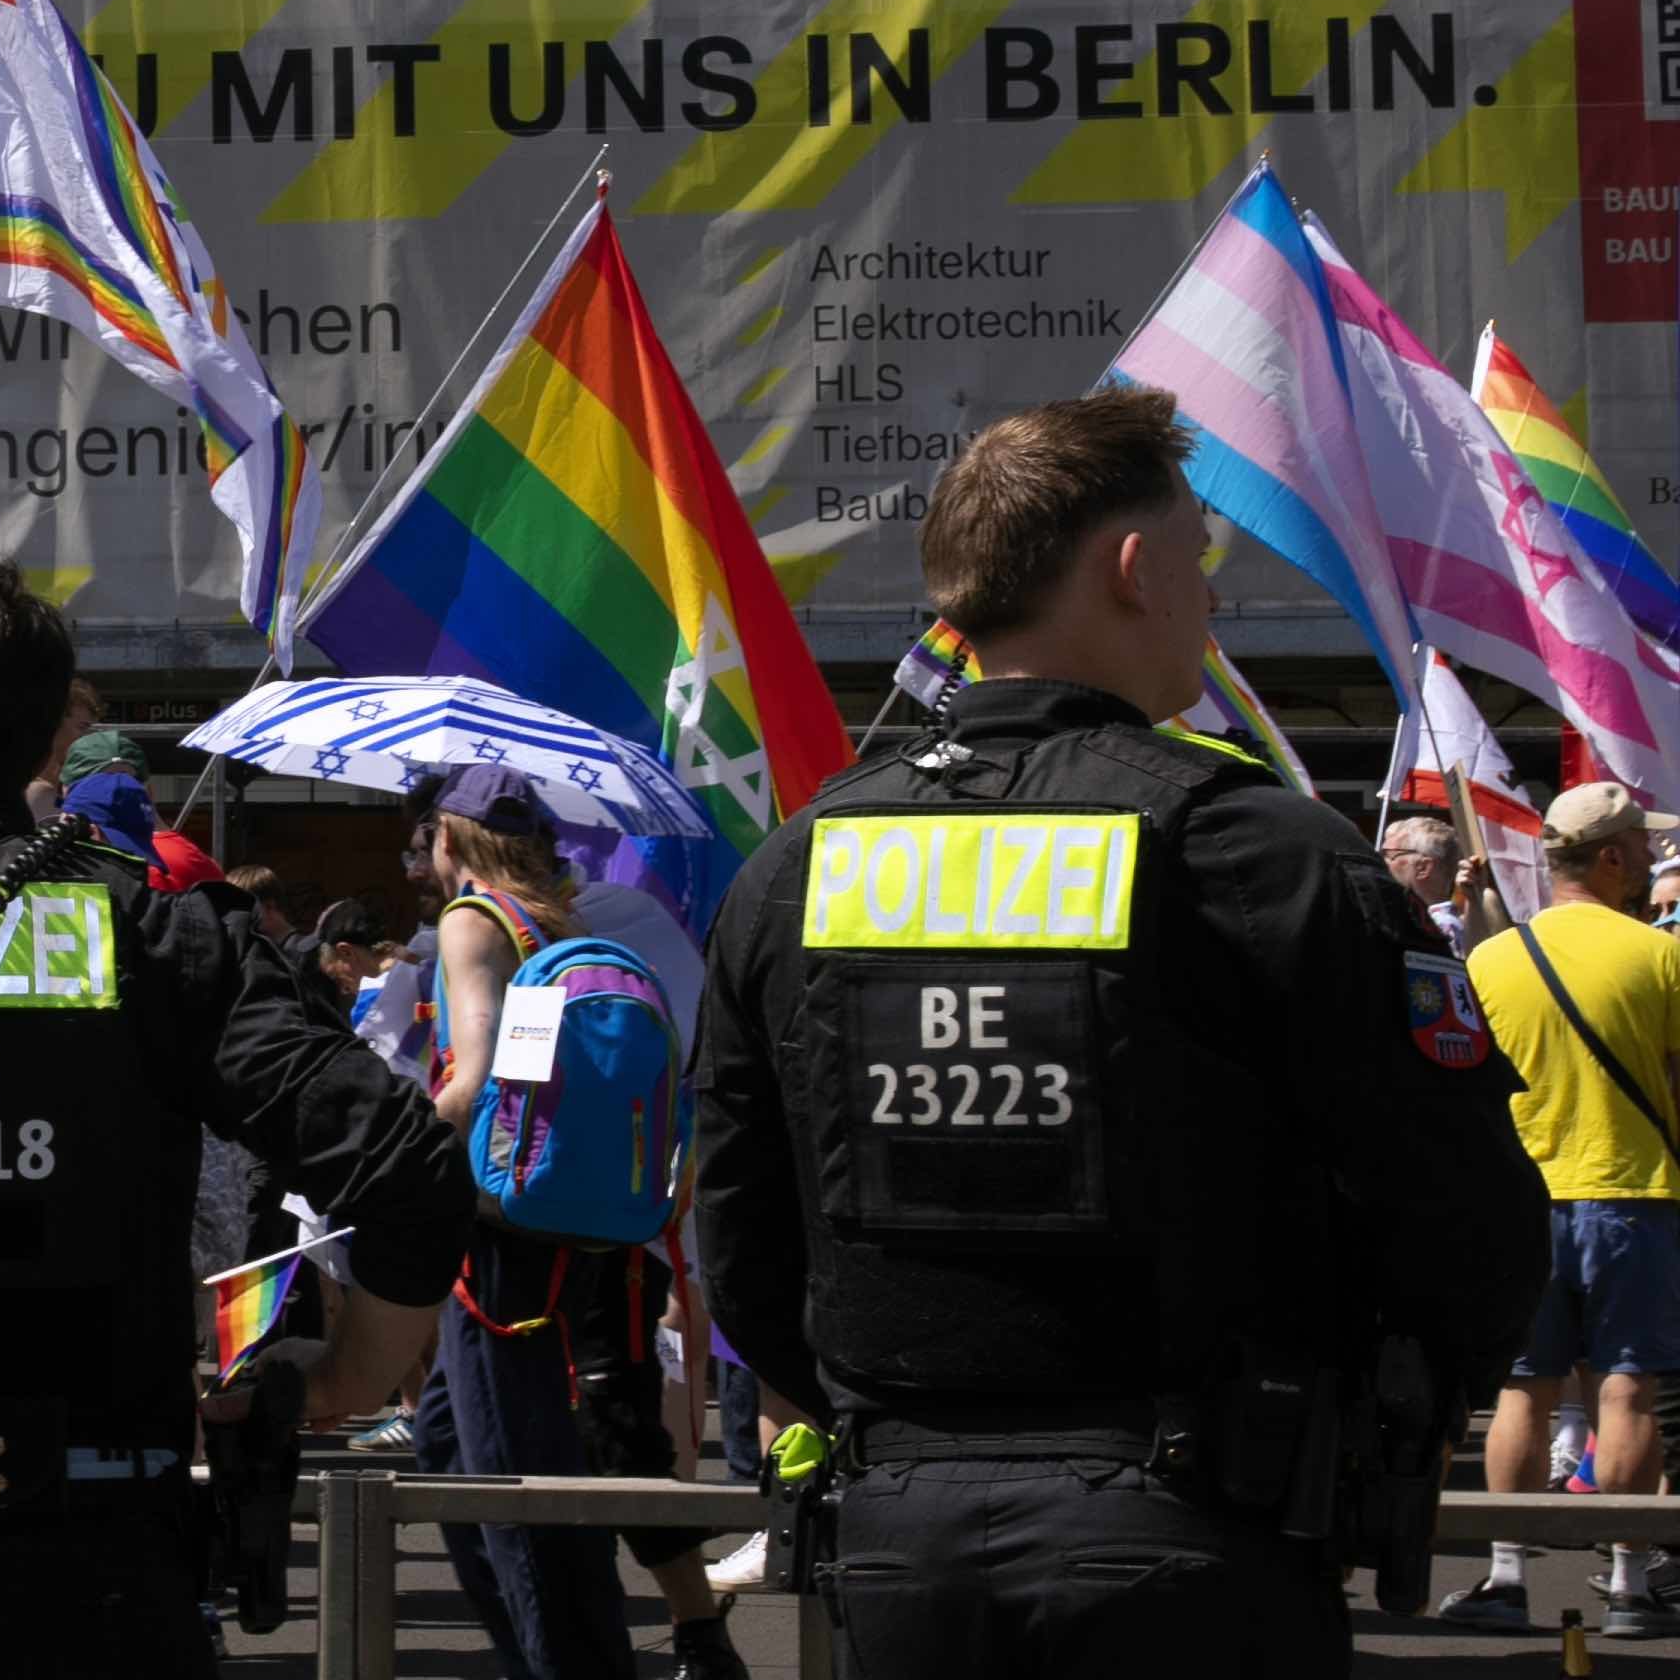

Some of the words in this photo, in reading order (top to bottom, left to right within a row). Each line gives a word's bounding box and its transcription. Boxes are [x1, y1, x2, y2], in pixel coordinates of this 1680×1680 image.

[211, 44, 441, 145] MIT
[487, 36, 758, 137] UNS
[806, 27, 932, 128] IN
[984, 12, 1498, 123] BERLIN.
[809, 241, 1051, 283] Architektur
[813, 298, 1124, 343] Elektrotechnik
[815, 363, 904, 403] HLS
[815, 827, 1127, 936] POLIZEI
[921, 986, 1009, 1049] BE
[868, 1063, 1073, 1126] 23223
